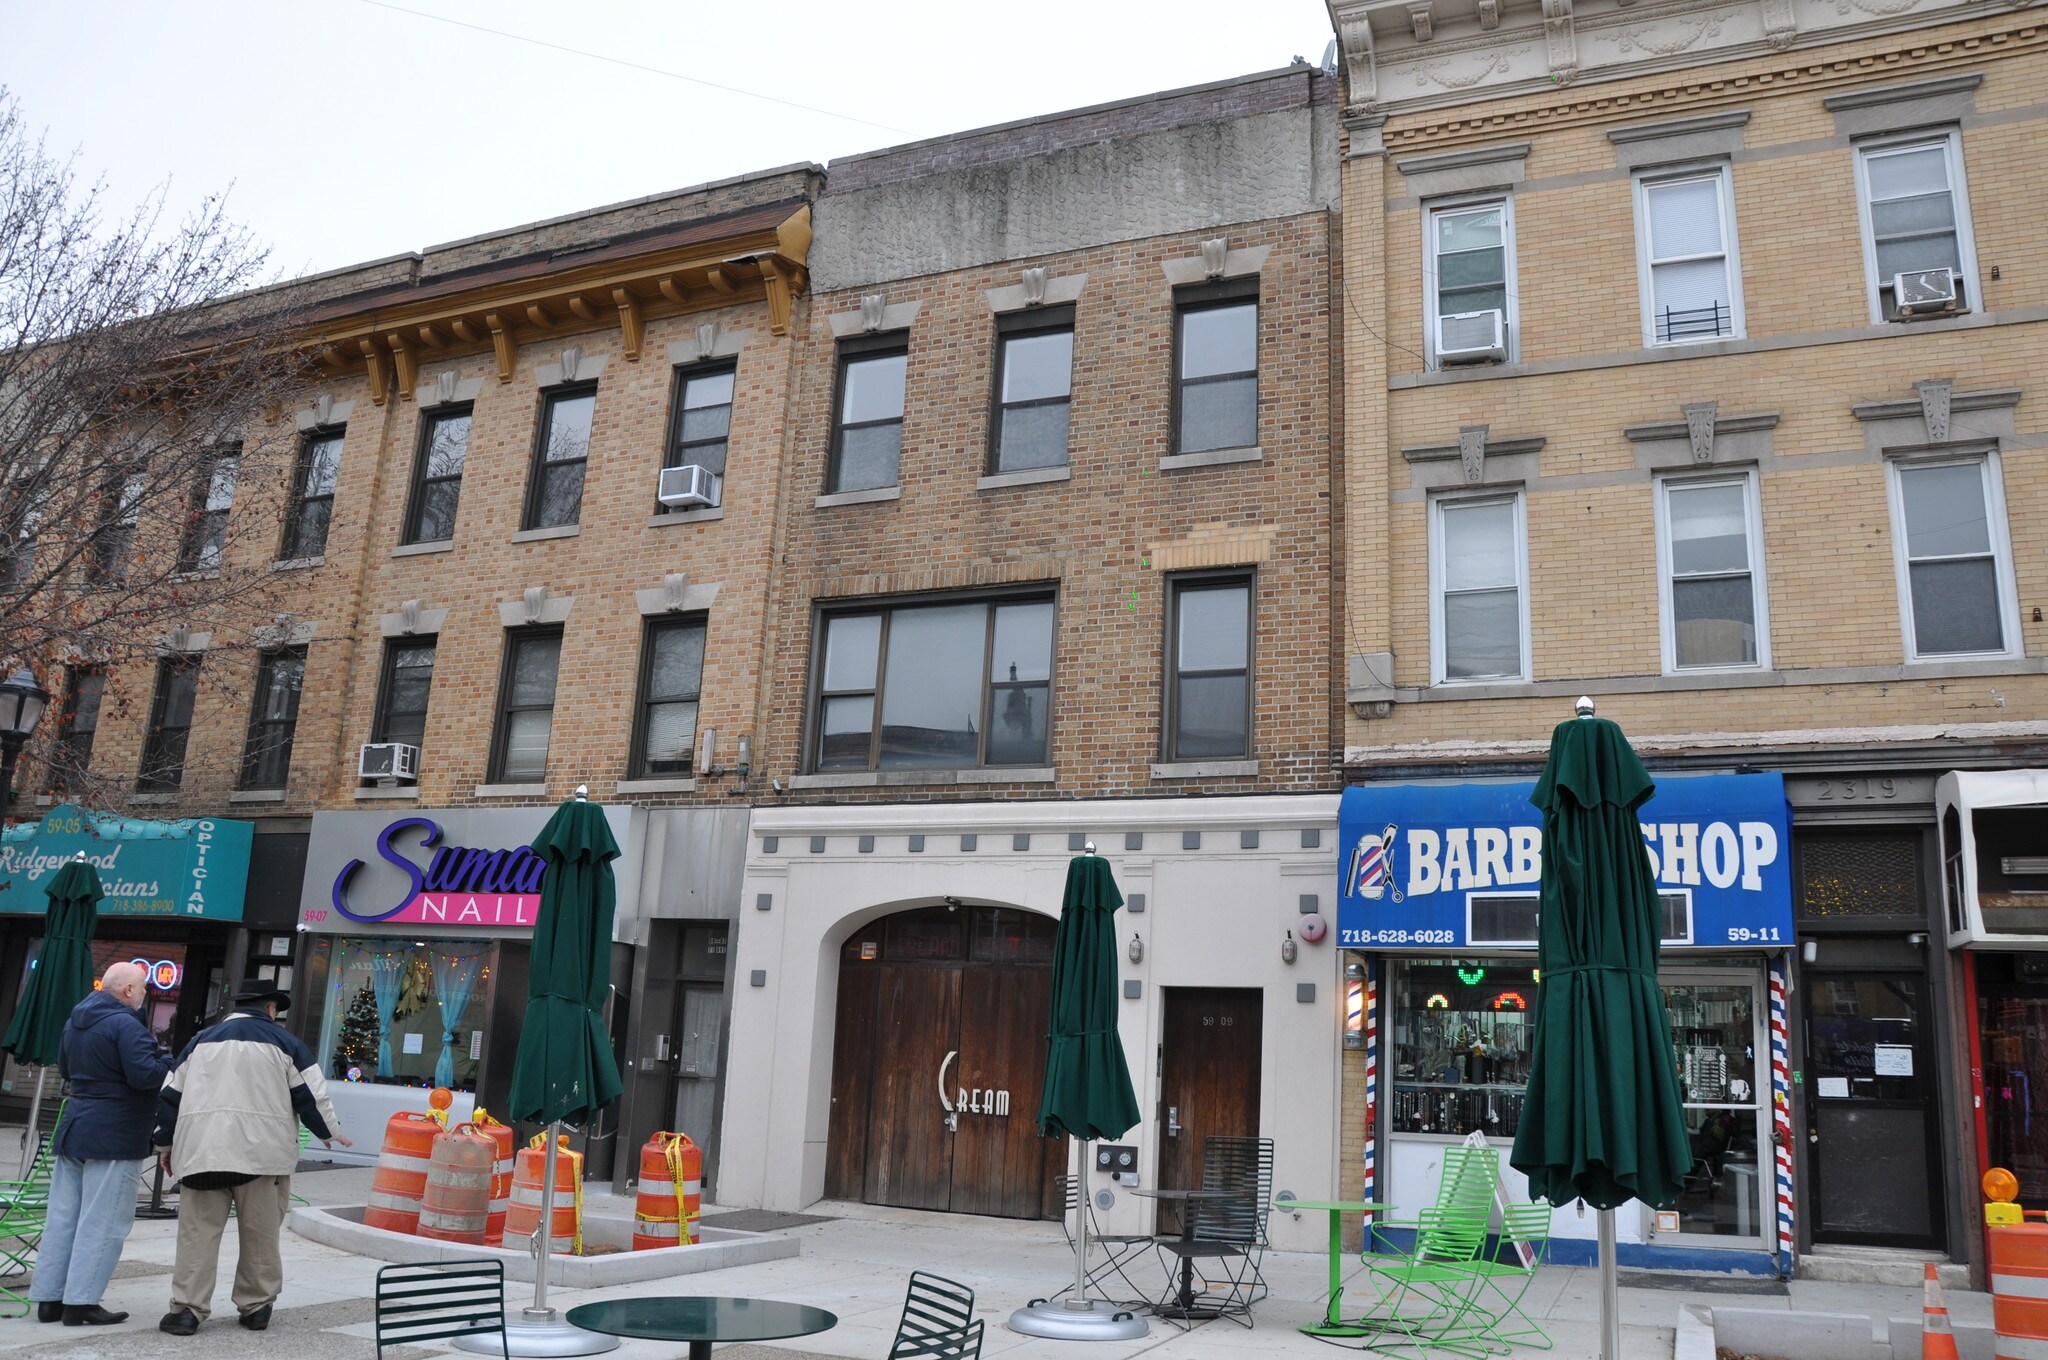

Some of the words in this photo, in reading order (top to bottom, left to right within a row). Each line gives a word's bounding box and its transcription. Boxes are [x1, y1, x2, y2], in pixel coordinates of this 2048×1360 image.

[1817, 778, 1897, 800] 2319
[47, 818, 80, 833] 59-05
[187, 820, 215, 914] OPTICIAN
[1407, 826, 1543, 897] BARB
[112, 899, 174, 912] 718-386-8900
[304, 910, 328, 922] 59-07
[1342, 929, 1455, 943] 718-628-6028
[1728, 927, 1780, 941] 59-11
[1202, 1016, 1214, 1026] 59
[1220, 1016, 1233, 1026] 09
[938, 1050, 1010, 1116] CREAM
